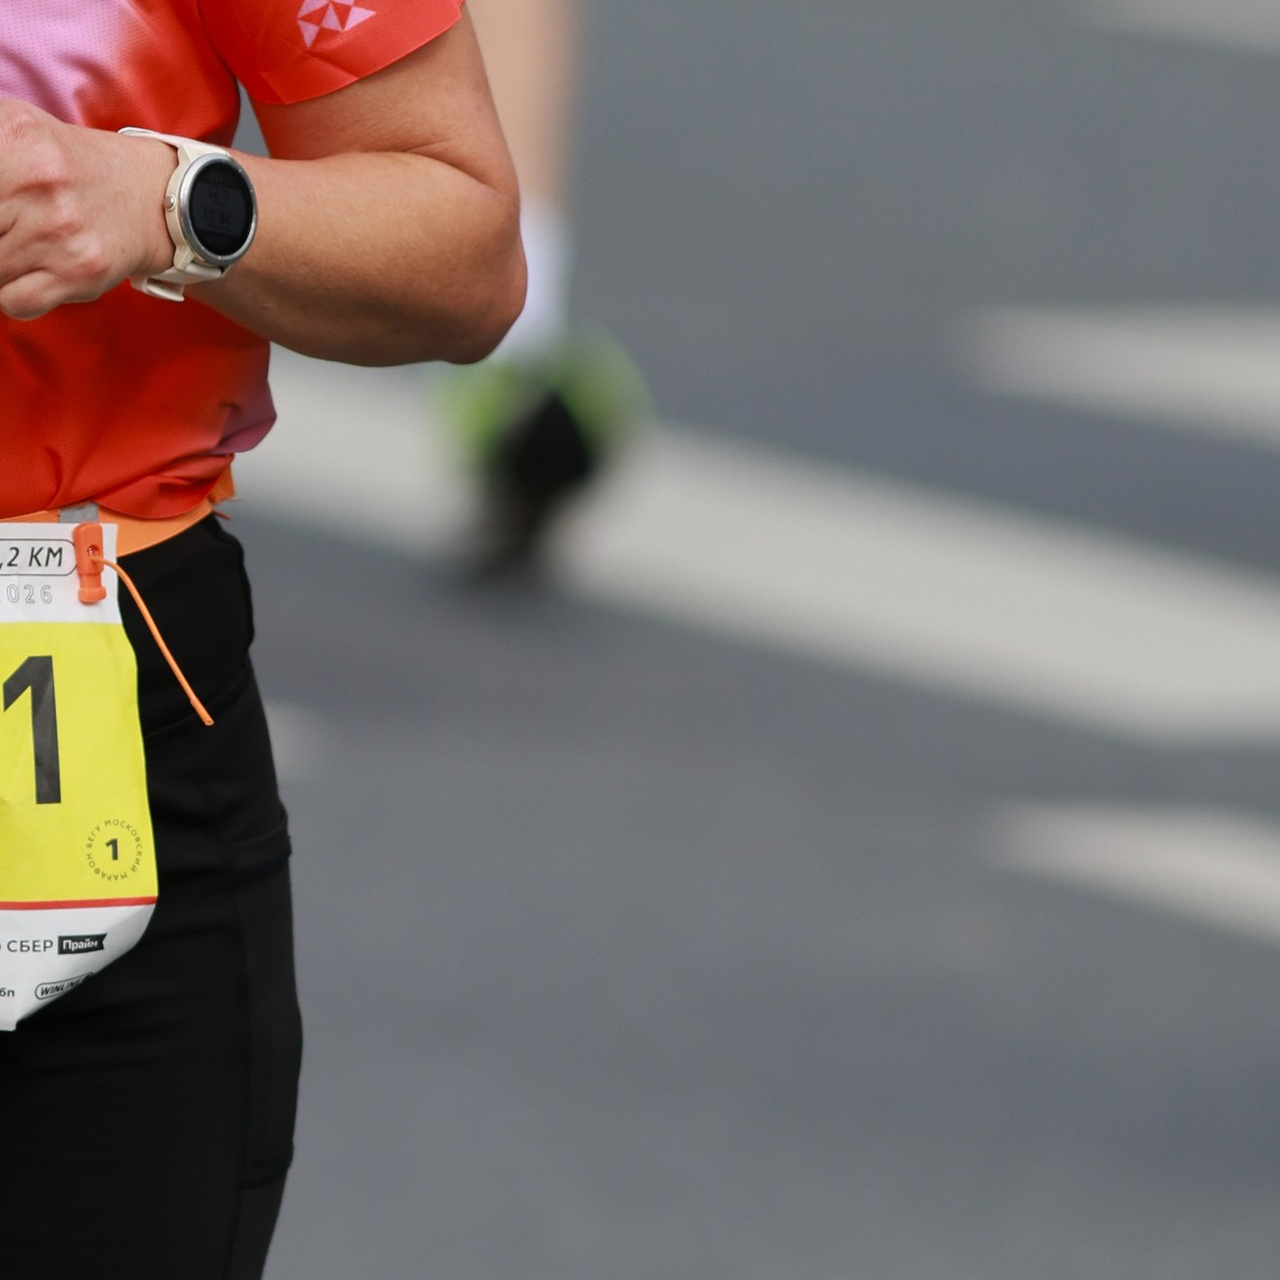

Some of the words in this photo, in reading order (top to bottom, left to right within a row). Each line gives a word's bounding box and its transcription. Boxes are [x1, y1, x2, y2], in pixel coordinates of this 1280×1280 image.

[105, 837, 118, 860] 1
[7, 940, 53, 952] СБЕР
[63, 938, 98, 951] Прайм
